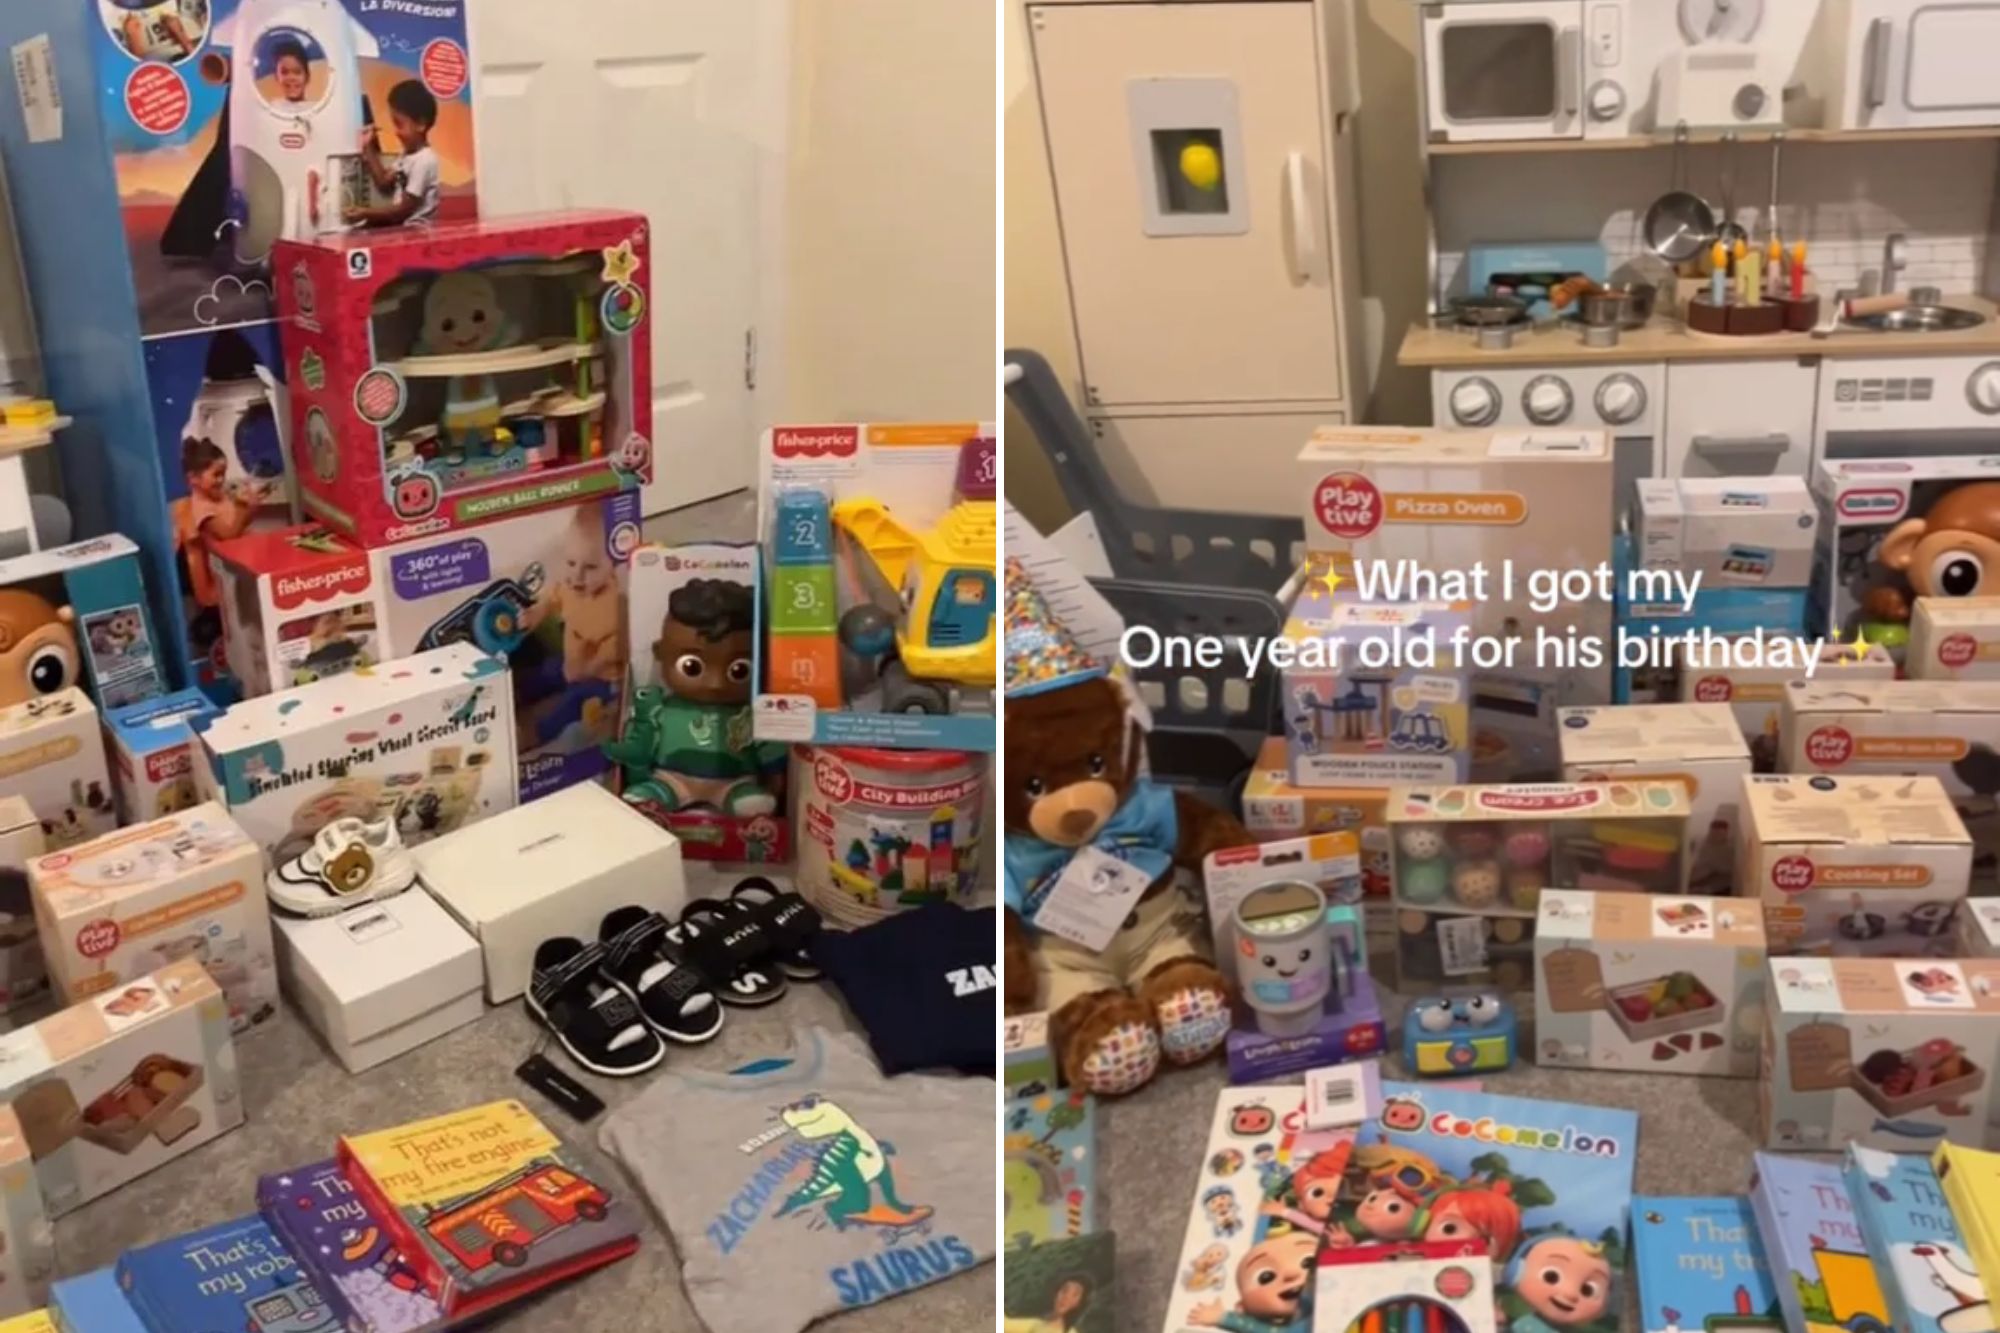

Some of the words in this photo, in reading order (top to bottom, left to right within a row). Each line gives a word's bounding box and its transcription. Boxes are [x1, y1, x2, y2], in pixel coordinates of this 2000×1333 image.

[1320, 486, 1374, 509] Play
[1395, 499, 1448, 514] Pizza
[1454, 499, 1507, 516] Oven
[1324, 506, 1372, 525] tive
[798, 521, 816, 545] 2
[277, 565, 366, 597] fisher-price
[816, 760, 847, 787] Play
[1361, 760, 1396, 770] POLICE
[1401, 760, 1443, 771] STATION
[861, 787, 894, 804] City
[897, 787, 961, 803] Building
[1776, 861, 1810, 876] Play
[1823, 866, 1890, 883] Cooking
[1893, 867, 1918, 881] Set
[944, 963, 996, 997] ZA
[391, 1135, 465, 1161] That's
[469, 1122, 510, 1143] not
[1431, 1112, 1617, 1156] CoComelon
[380, 1168, 424, 1188] my
[422, 1155, 466, 1176] fire
[467, 1138, 536, 1163] engine
[321, 1199, 367, 1224] my
[1908, 1210, 1957, 1241] my
[184, 1238, 266, 1272] That's
[1678, 1253, 1725, 1281] my
[830, 1235, 974, 1306] SAURUS
[198, 1271, 247, 1297] my
